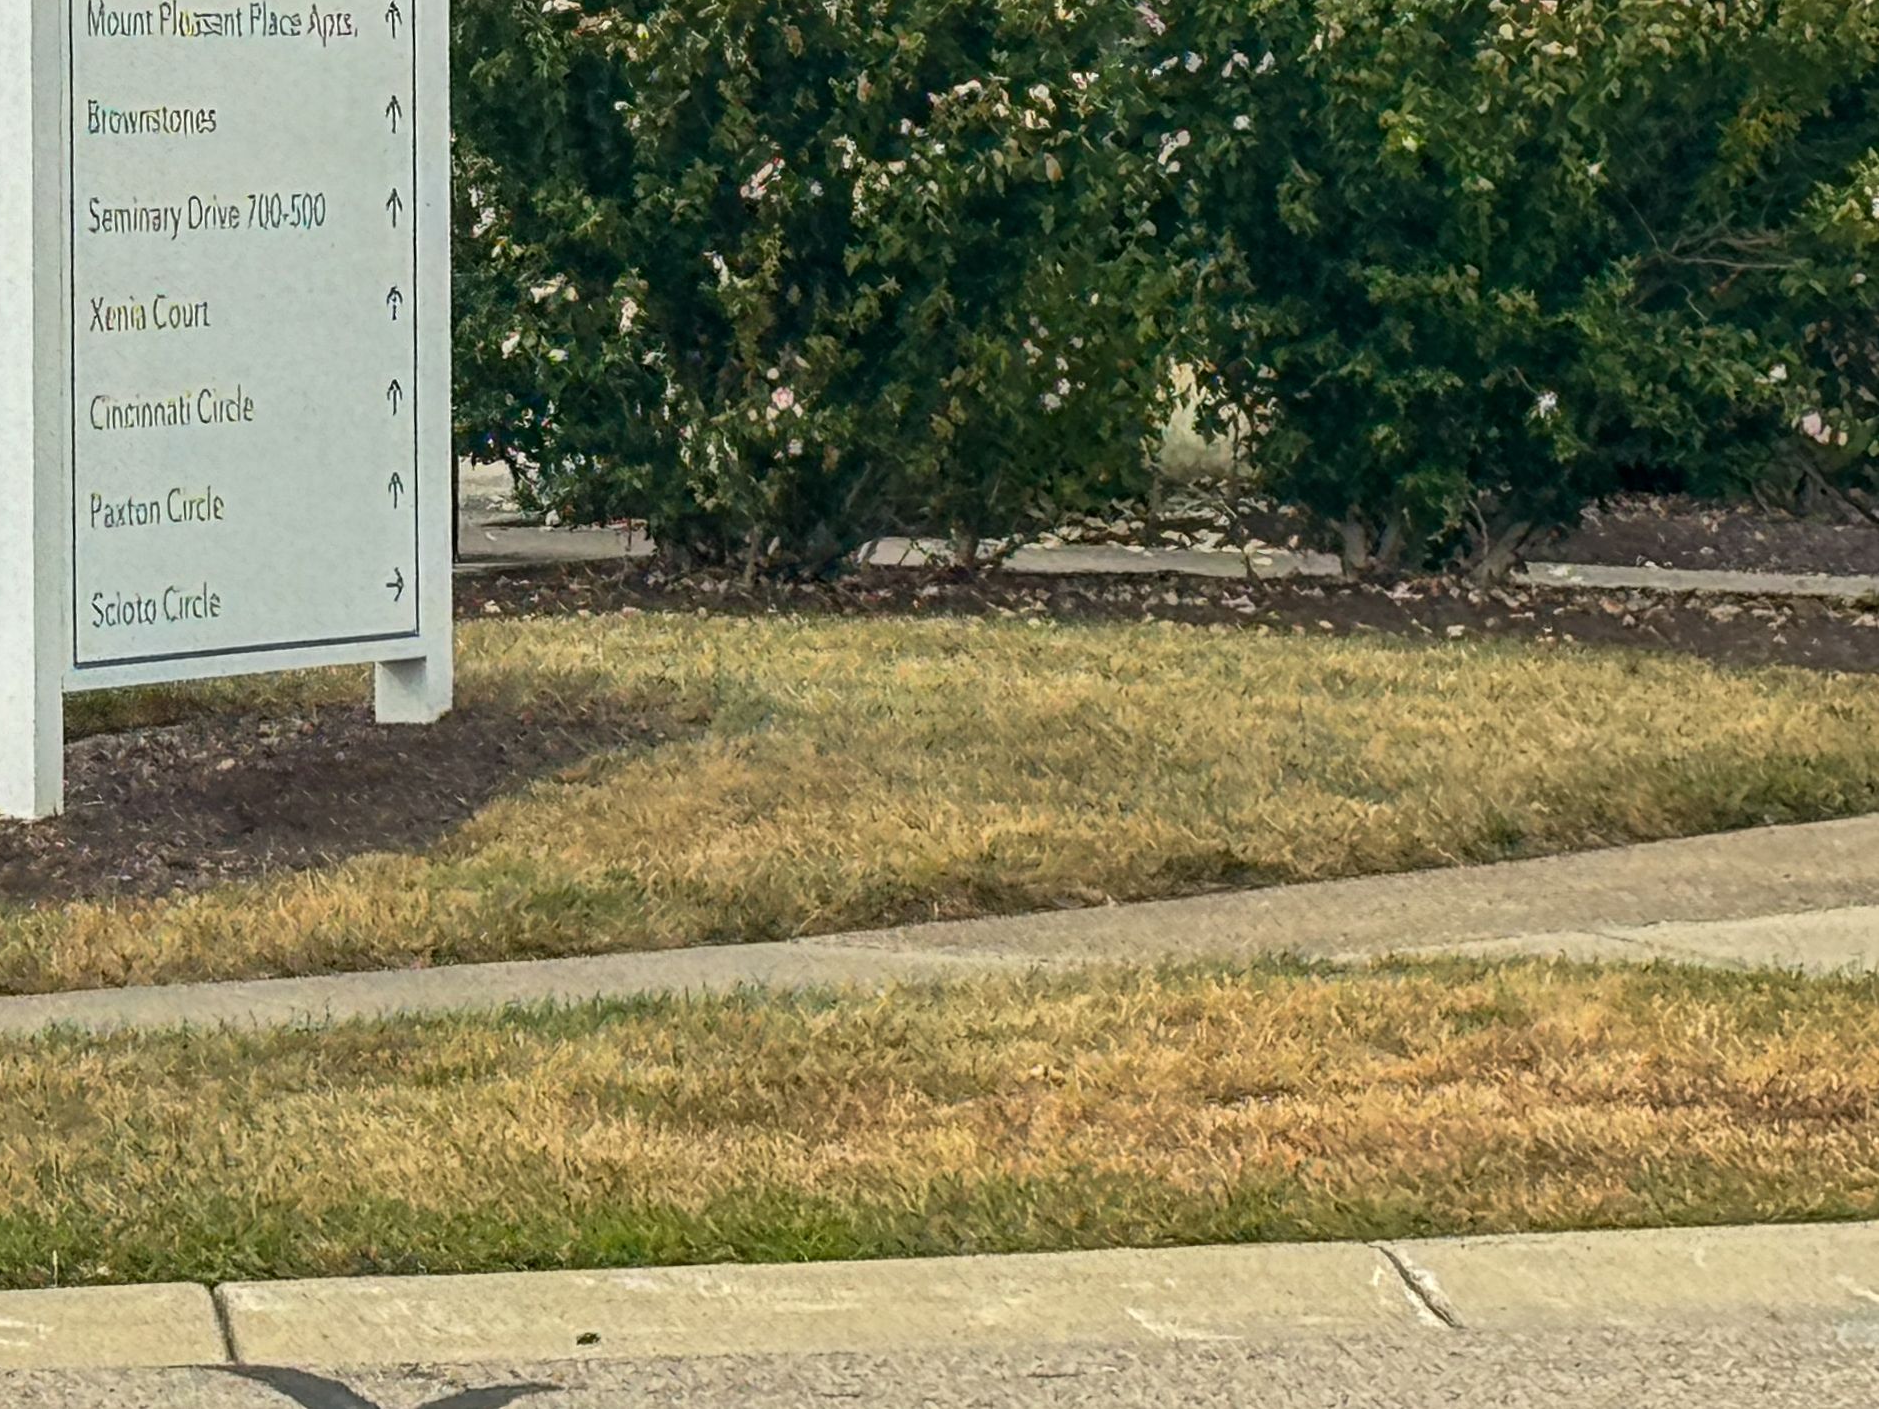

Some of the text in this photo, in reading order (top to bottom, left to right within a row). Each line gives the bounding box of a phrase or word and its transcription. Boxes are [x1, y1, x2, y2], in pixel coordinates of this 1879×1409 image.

[88, 0, 357, 47] Mount Pleasant Place Apts.
[88, 99, 216, 136] Brownstones
[89, 197, 181, 240] Seminary
[188, 195, 239, 229] Drive
[90, 294, 210, 332] Xenia Court
[90, 384, 253, 430] Cincinnati Circle
[91, 486, 224, 528] Paxton Circle
[92, 582, 220, 628] Scioto Circle
